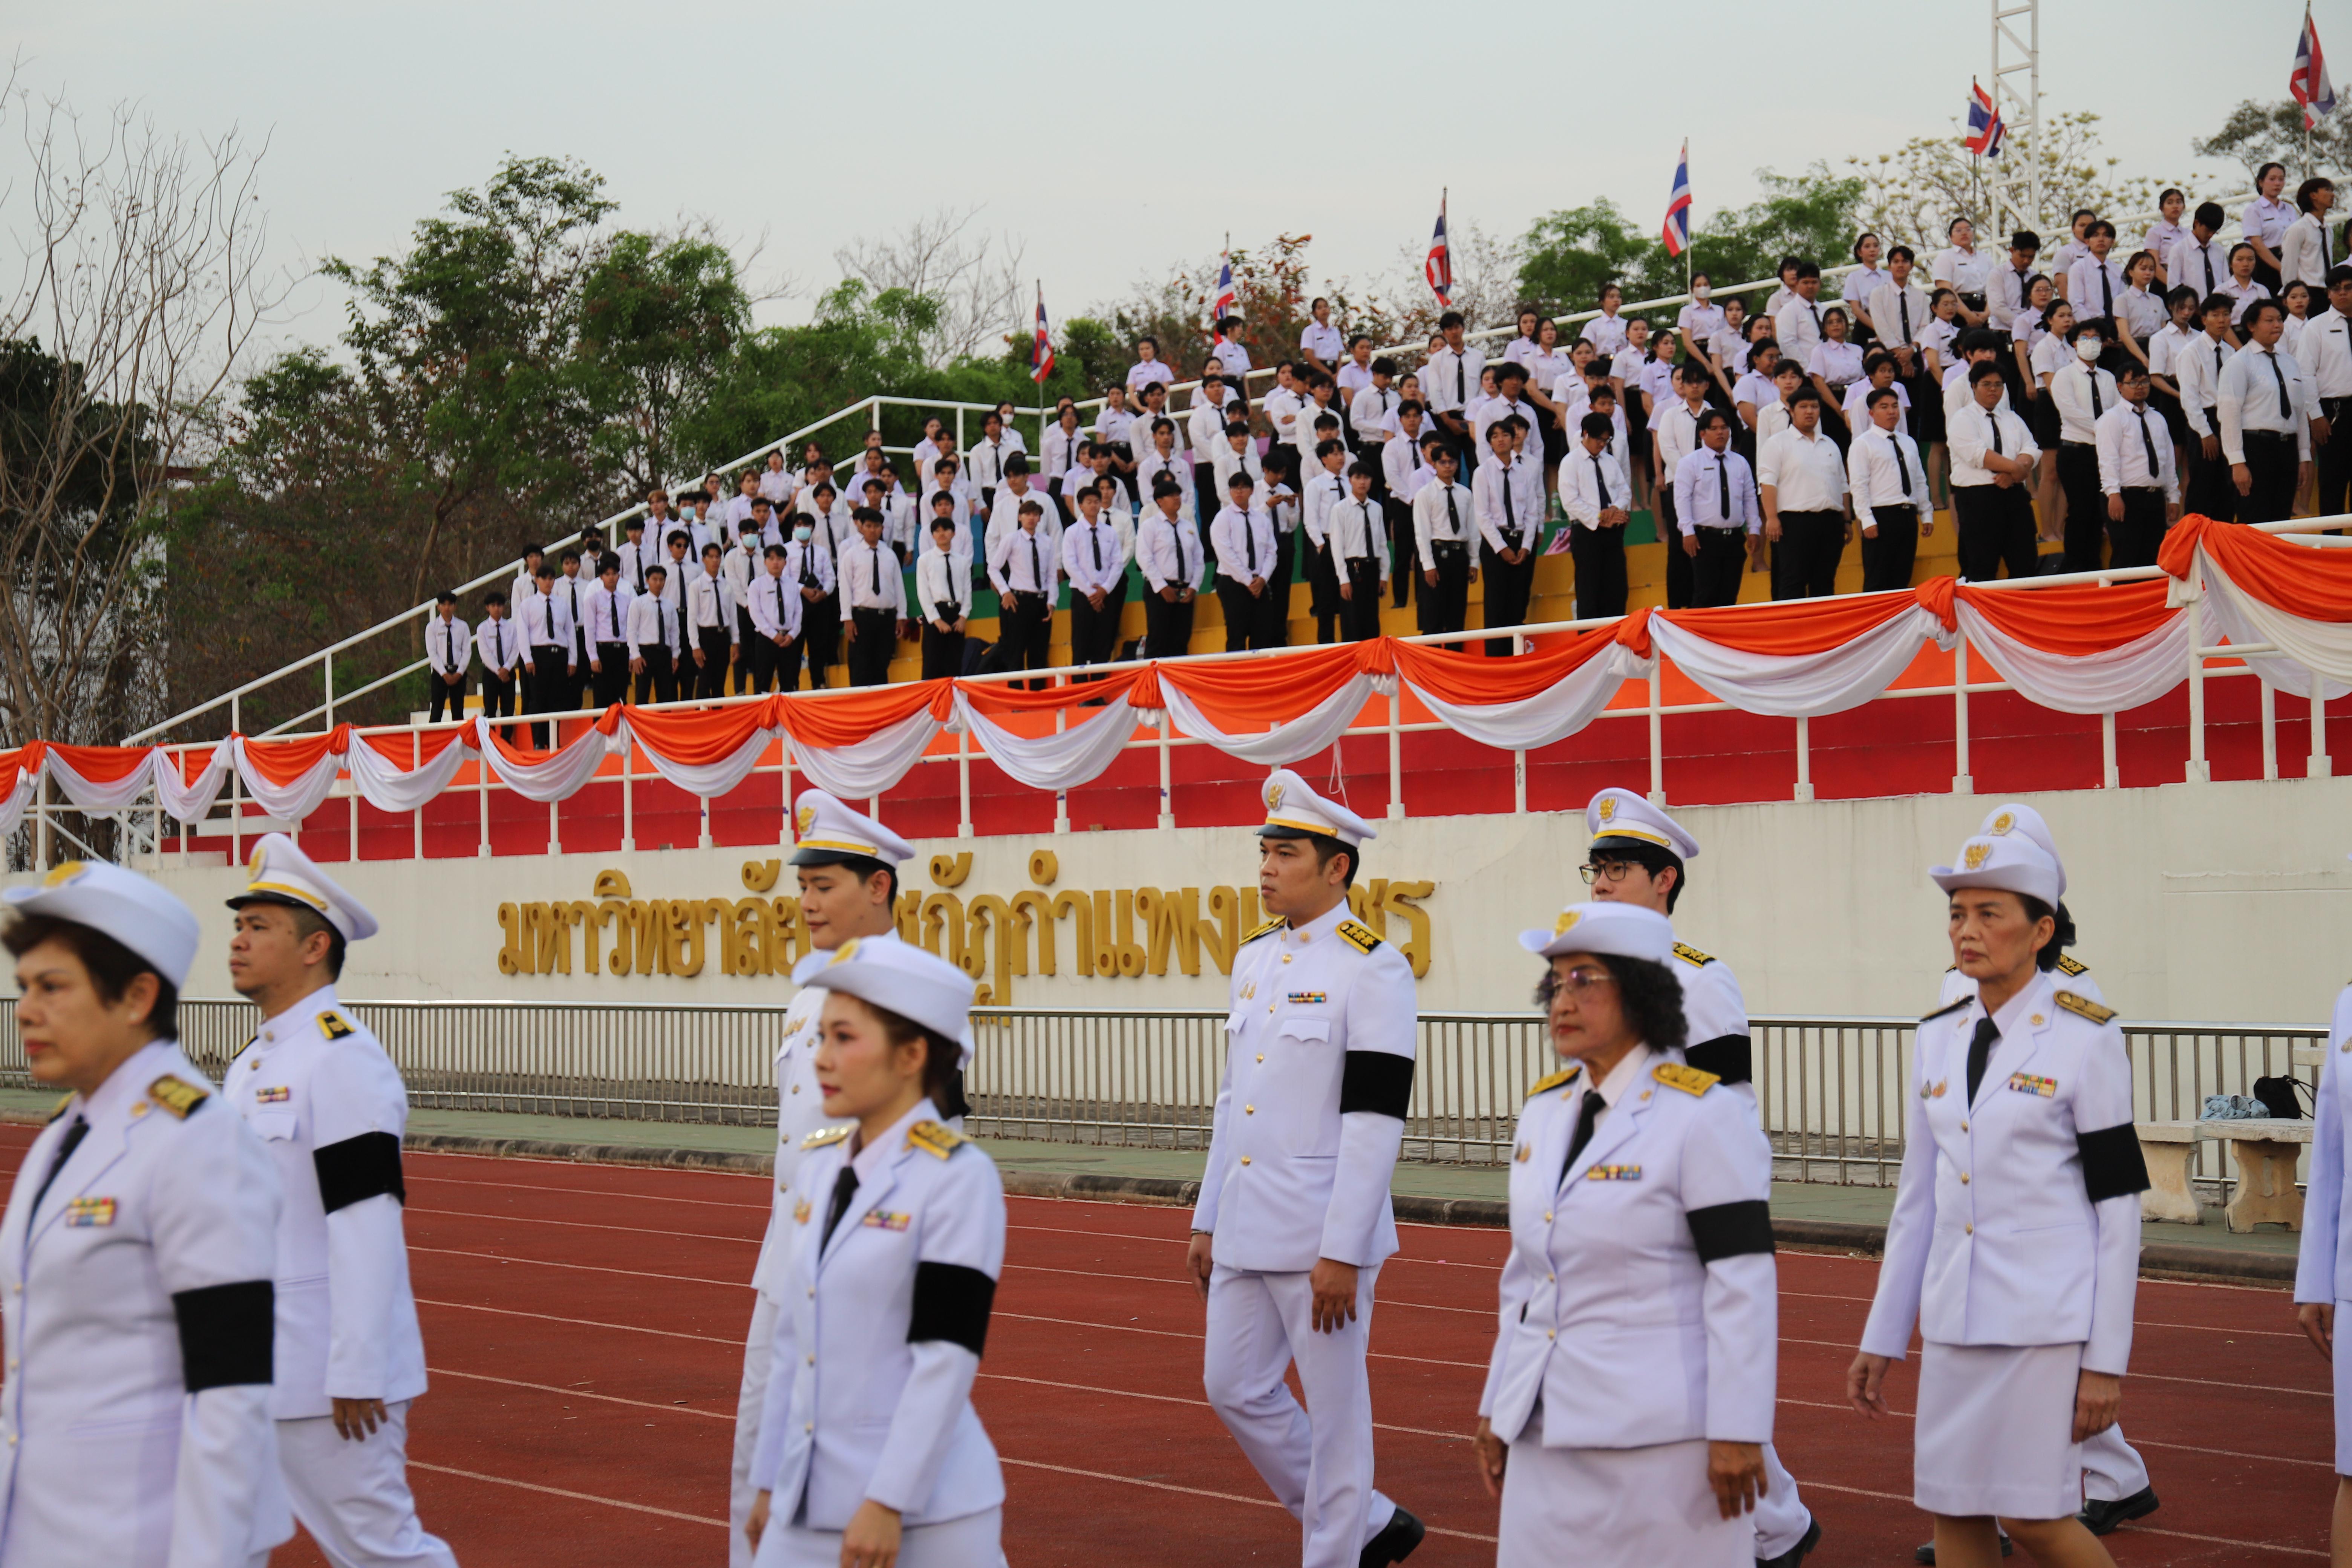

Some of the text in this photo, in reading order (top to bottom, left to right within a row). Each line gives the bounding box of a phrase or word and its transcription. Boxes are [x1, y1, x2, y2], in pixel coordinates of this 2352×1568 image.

[498, 850, 1435, 1027] มหาวิทยาลัยภัฏกำแพงร
